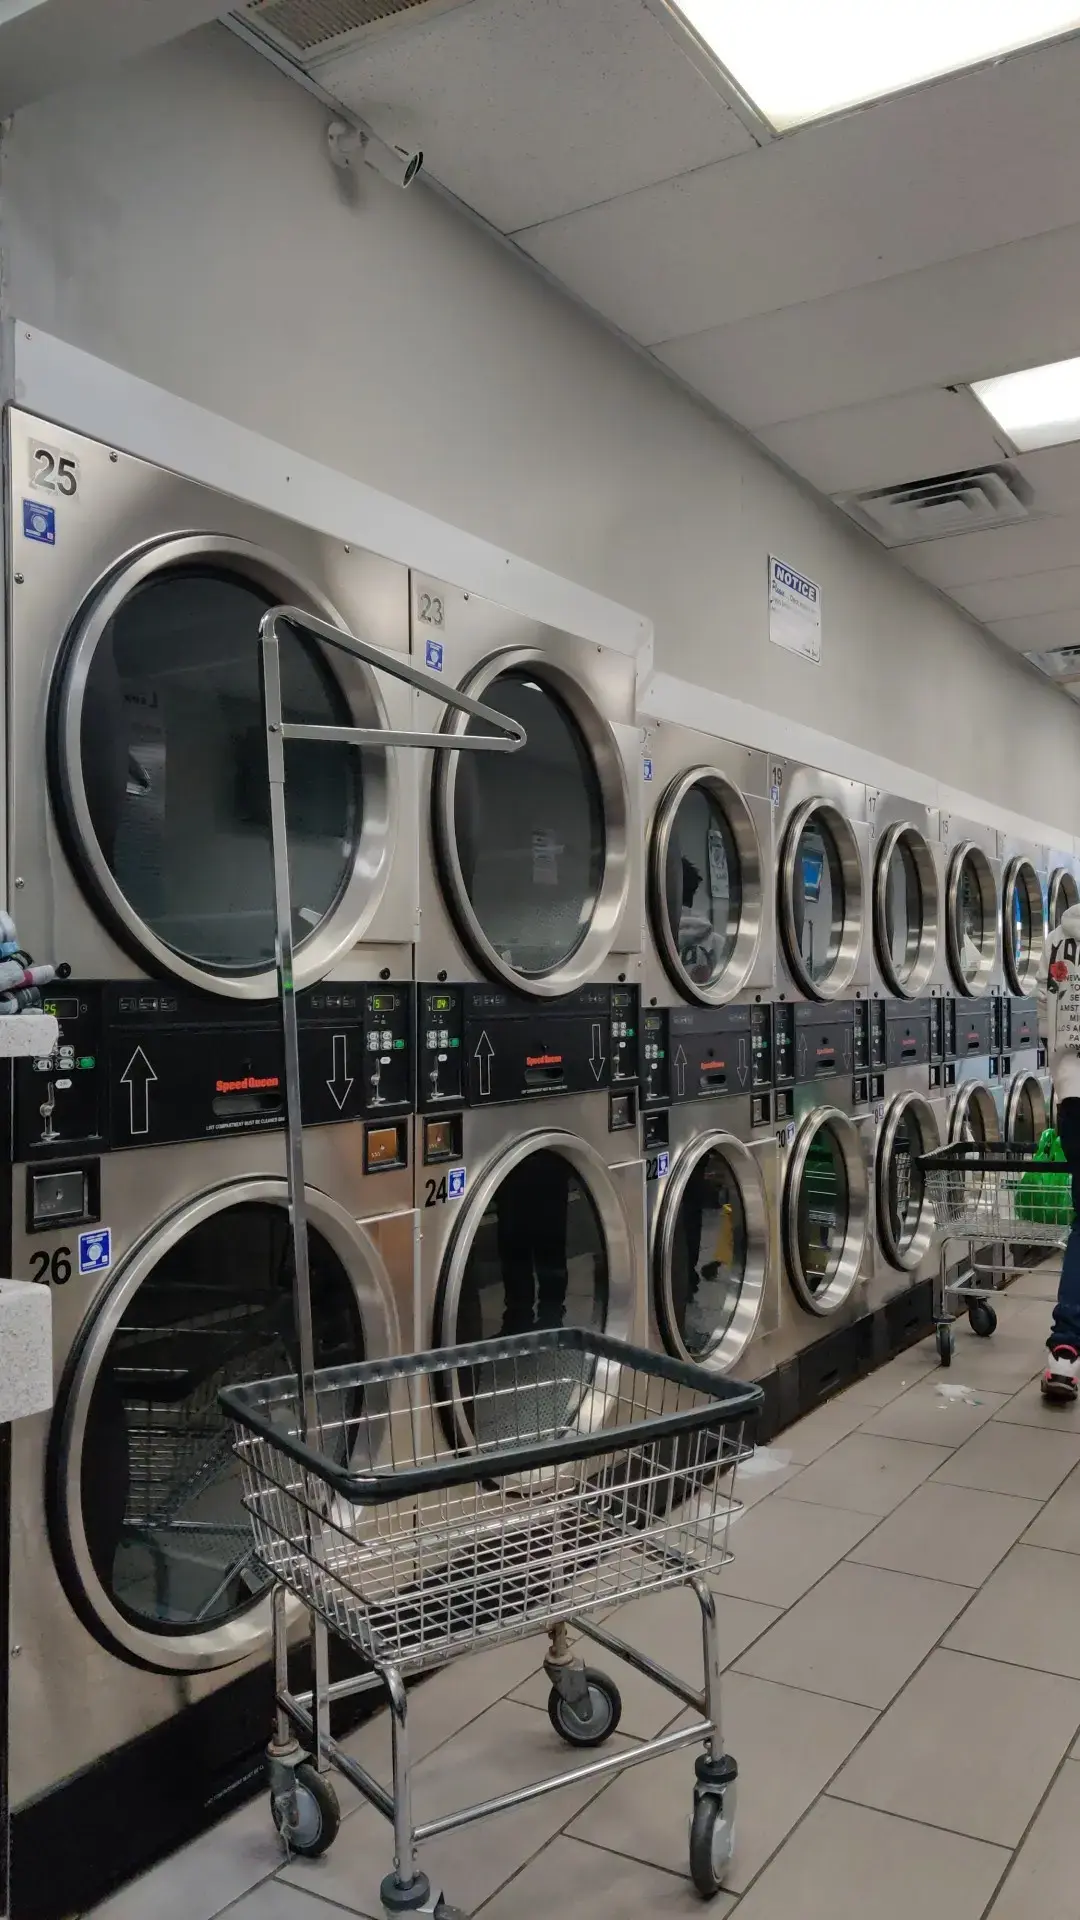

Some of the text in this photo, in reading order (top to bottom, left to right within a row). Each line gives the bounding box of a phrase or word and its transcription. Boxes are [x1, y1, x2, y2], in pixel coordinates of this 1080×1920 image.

[34, 449, 77, 496] 25
[776, 565, 816, 603] NOTICE
[421, 593, 443, 625] 23
[773, 767, 783, 786] 19
[868, 796, 877, 813] 17
[216, 1077, 279, 1093] Speed Queen
[425, 1176, 448, 1208] 24
[28, 1246, 72, 1286] 26
